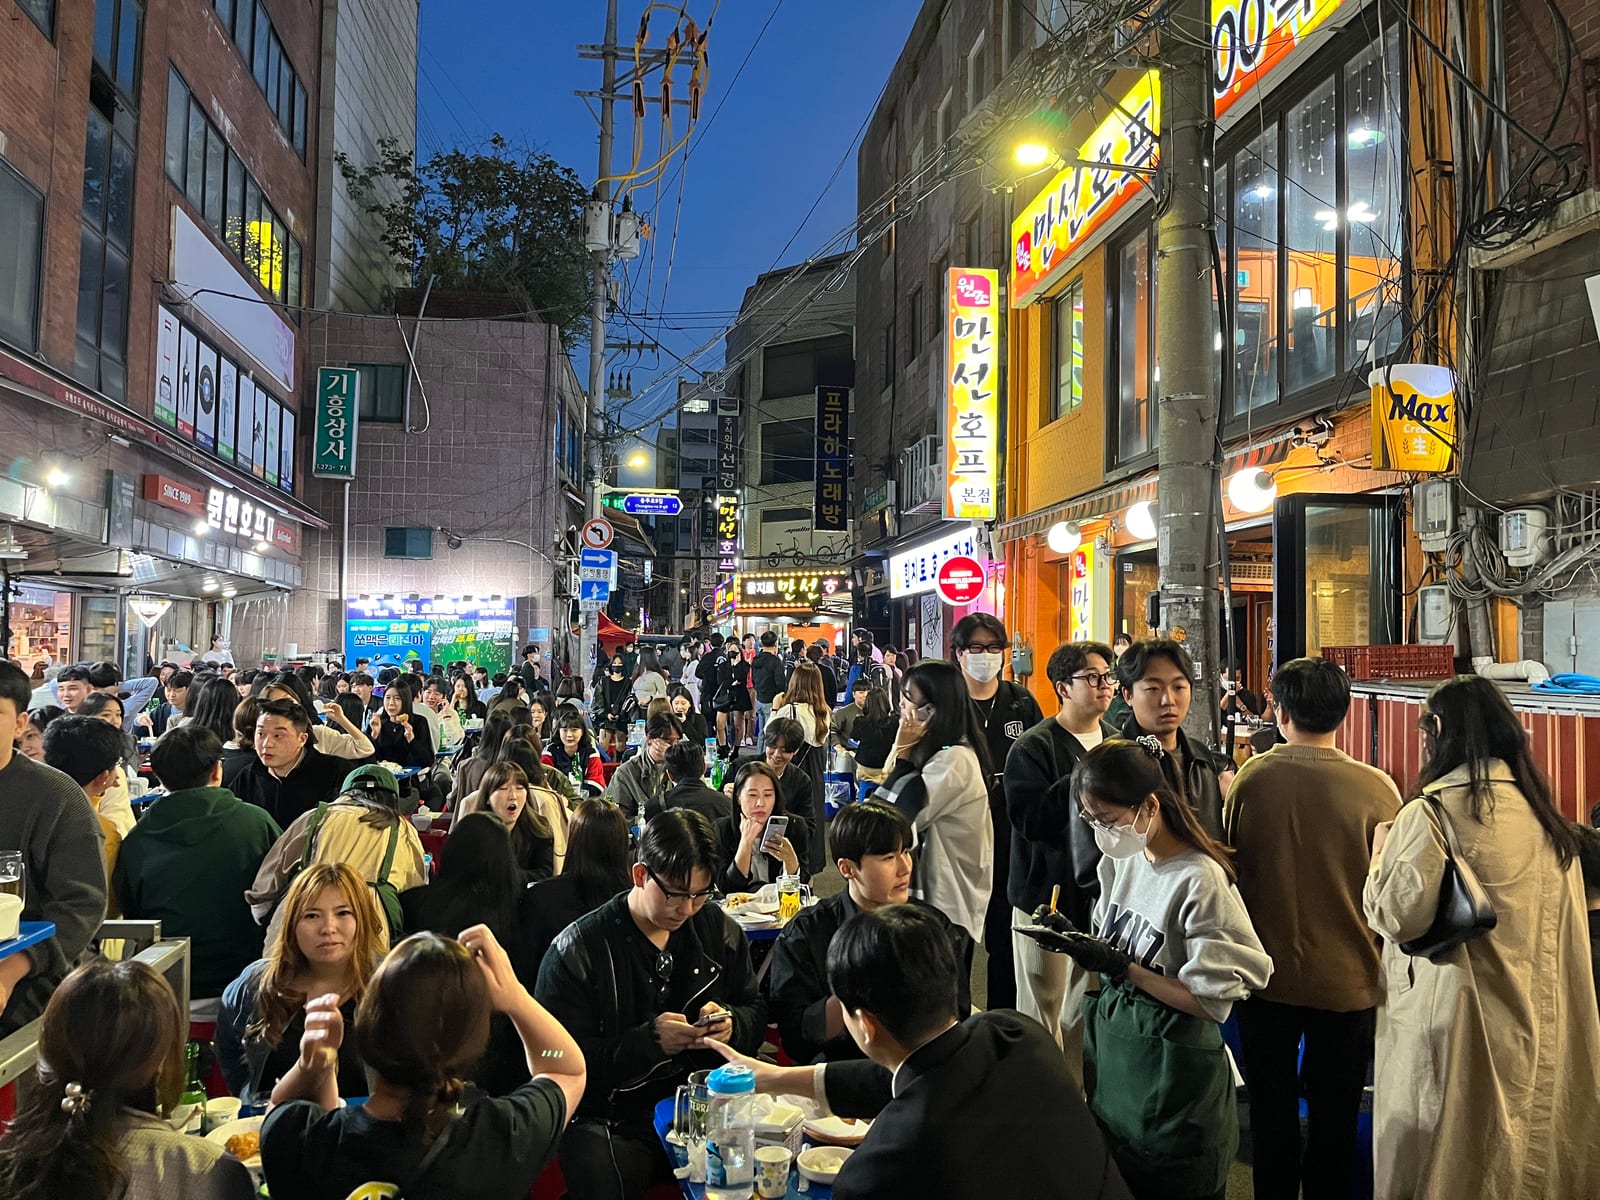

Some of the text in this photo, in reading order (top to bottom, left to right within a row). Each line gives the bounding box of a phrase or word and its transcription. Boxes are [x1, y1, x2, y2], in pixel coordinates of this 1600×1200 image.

[1032, 98, 1155, 266] 만선호프
[1015, 240, 1031, 270] 원조
[957, 277, 990, 305] 원조
[953, 316, 992, 475] 만선호프
[321, 373, 349, 461] 기흥상사
[1388, 393, 1451, 423] Max
[1403, 423, 1431, 434] Crea
[1412, 436, 1428, 455] 生
[163, 484, 192, 505] SINCE 1989
[961, 487, 991, 504] 본점
[206, 487, 266, 542] 뮌헨호프
[582, 568, 609, 579] 일방통행
[746, 581, 776, 595] 을지로
[354, 633, 424, 646] 쏘맥은 테진아
